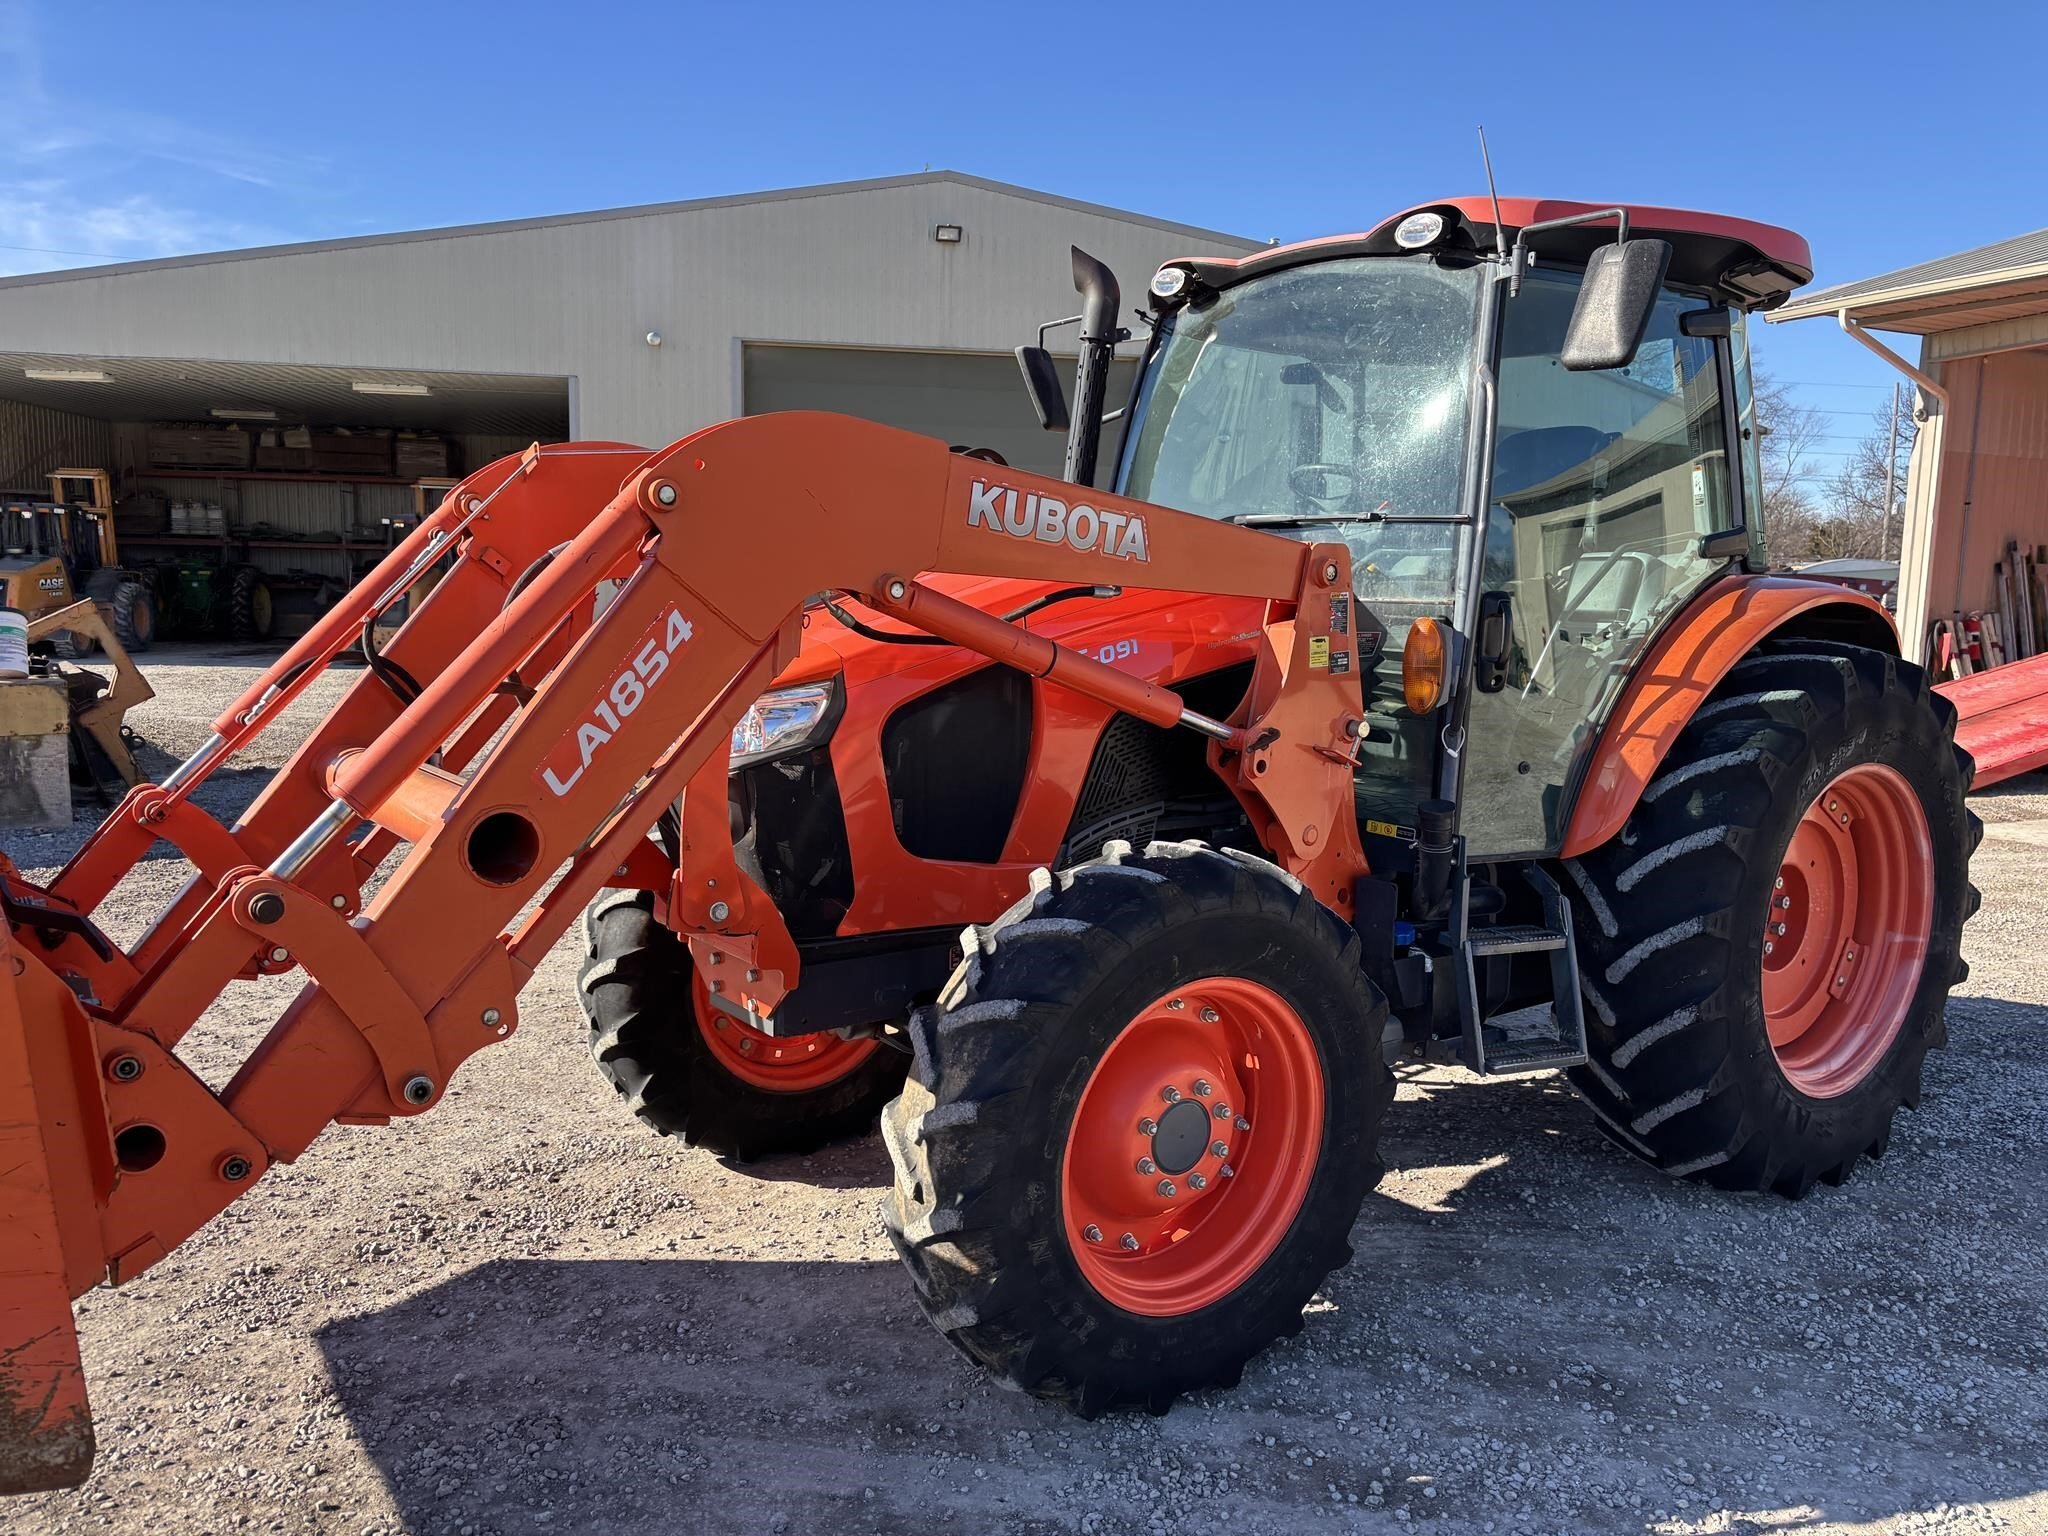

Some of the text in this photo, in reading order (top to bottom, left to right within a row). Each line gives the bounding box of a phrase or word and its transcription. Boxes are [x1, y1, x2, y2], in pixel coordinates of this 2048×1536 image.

[967, 480, 1148, 562] KUBOTA
[39, 577, 64, 590] CASE
[542, 608, 693, 797] LA1854
